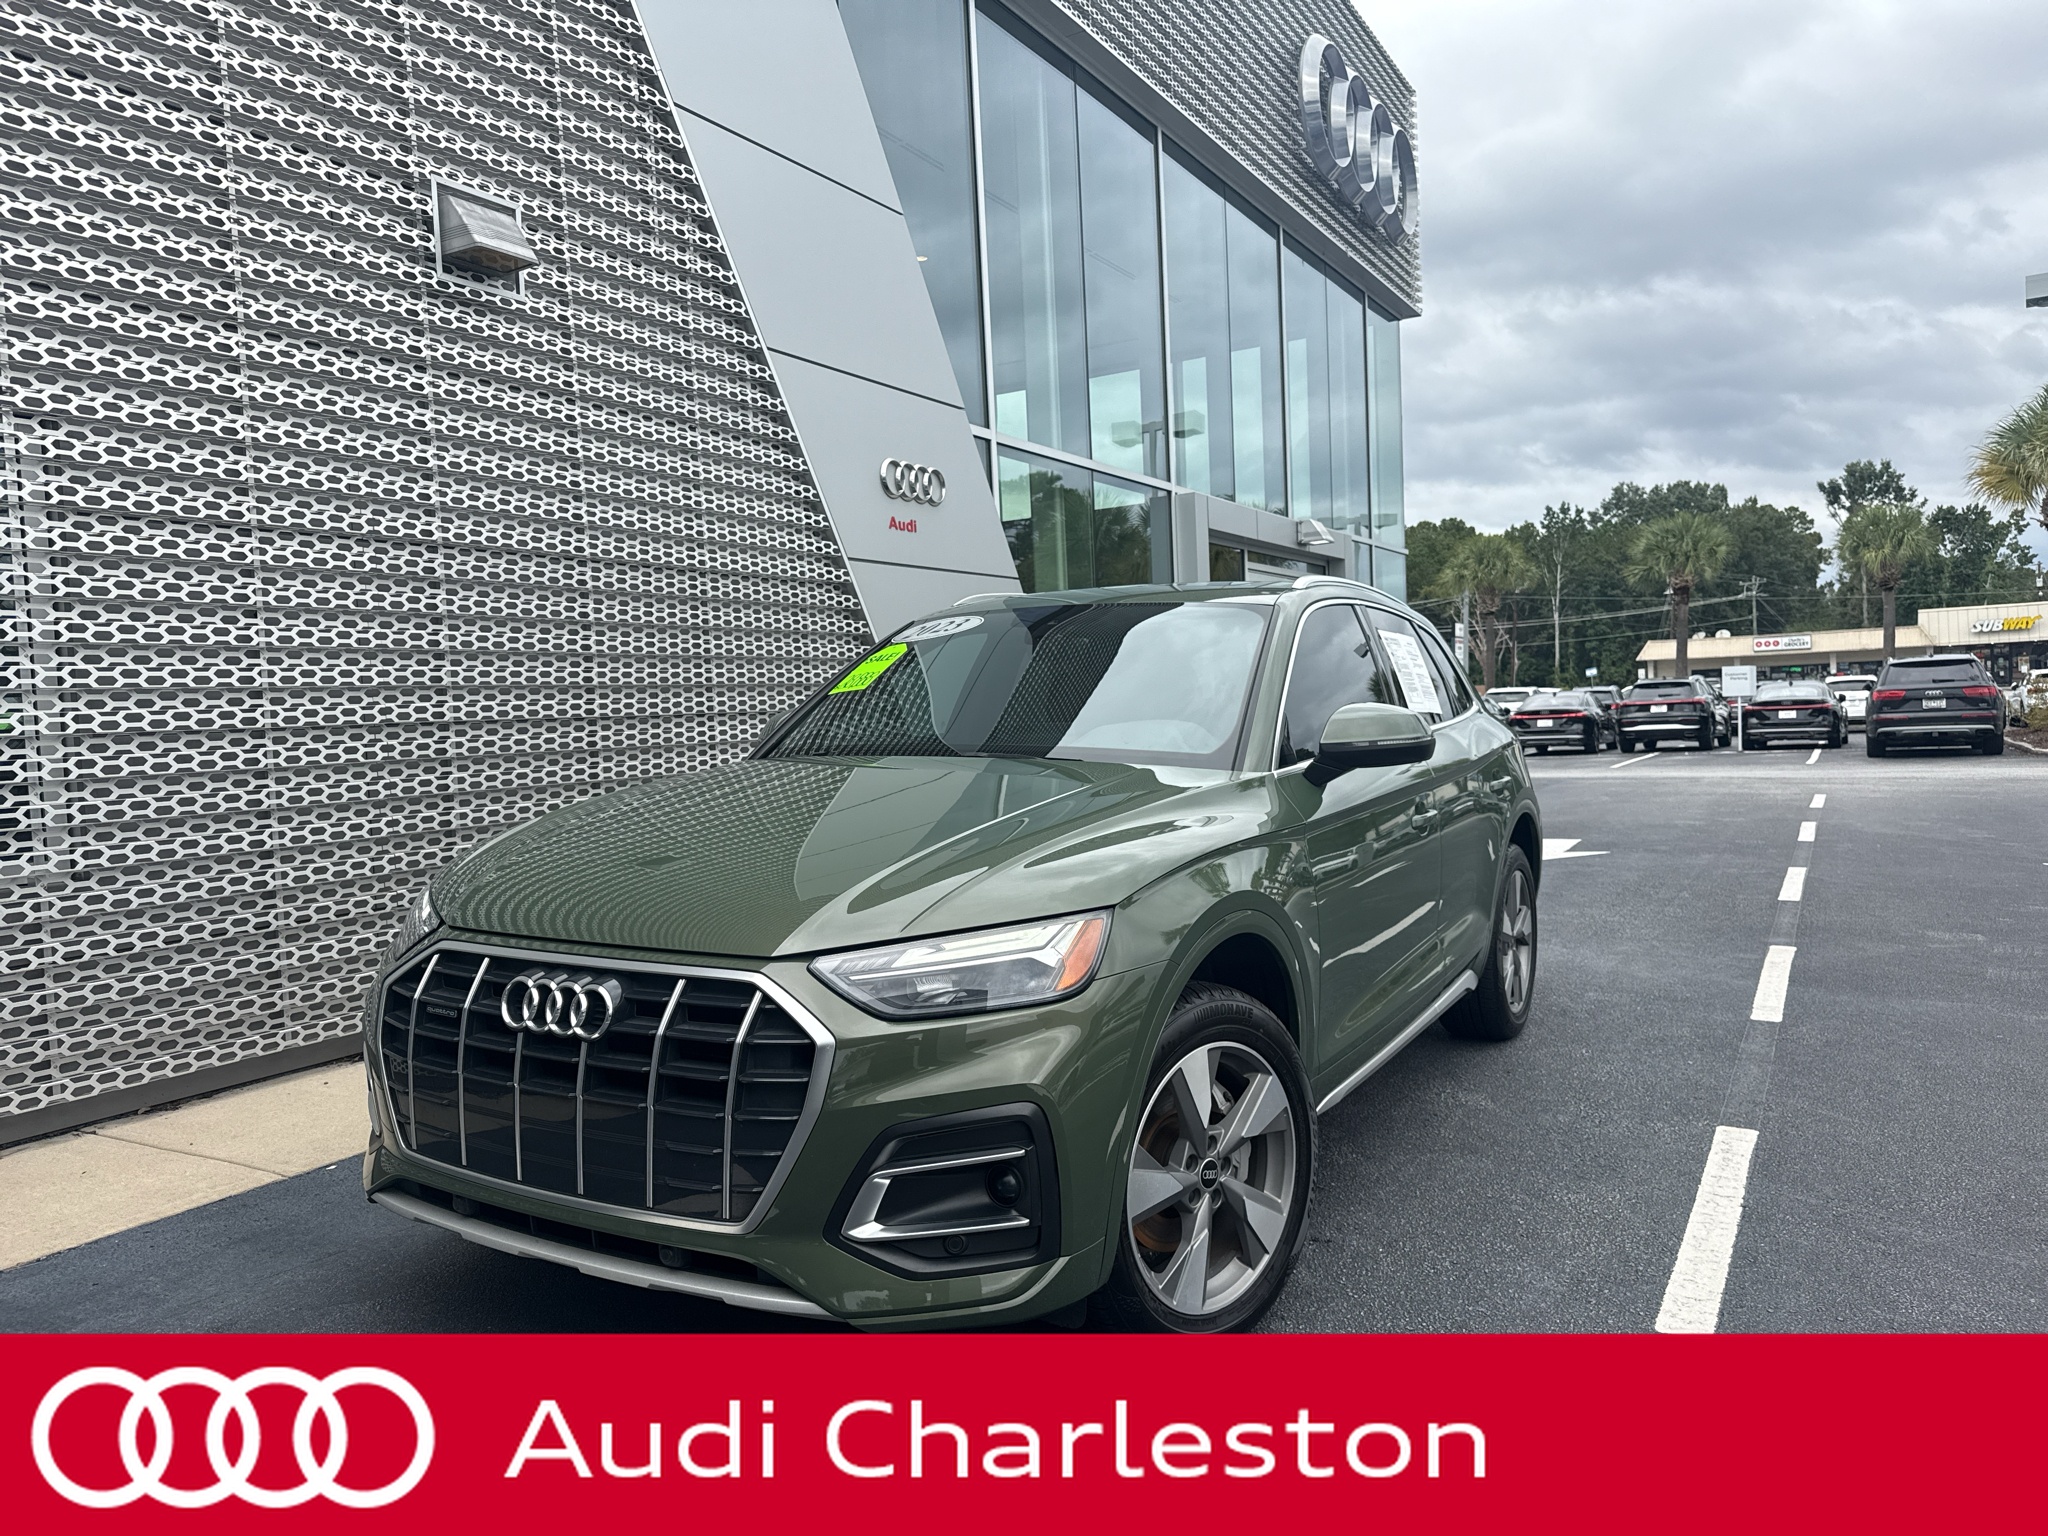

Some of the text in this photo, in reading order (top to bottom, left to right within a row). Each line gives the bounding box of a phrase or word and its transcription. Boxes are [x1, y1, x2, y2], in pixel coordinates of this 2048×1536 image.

[888, 515, 917, 533] Audi
[901, 618, 971, 640] 2023
[1971, 614, 2042, 632] SUBWAY
